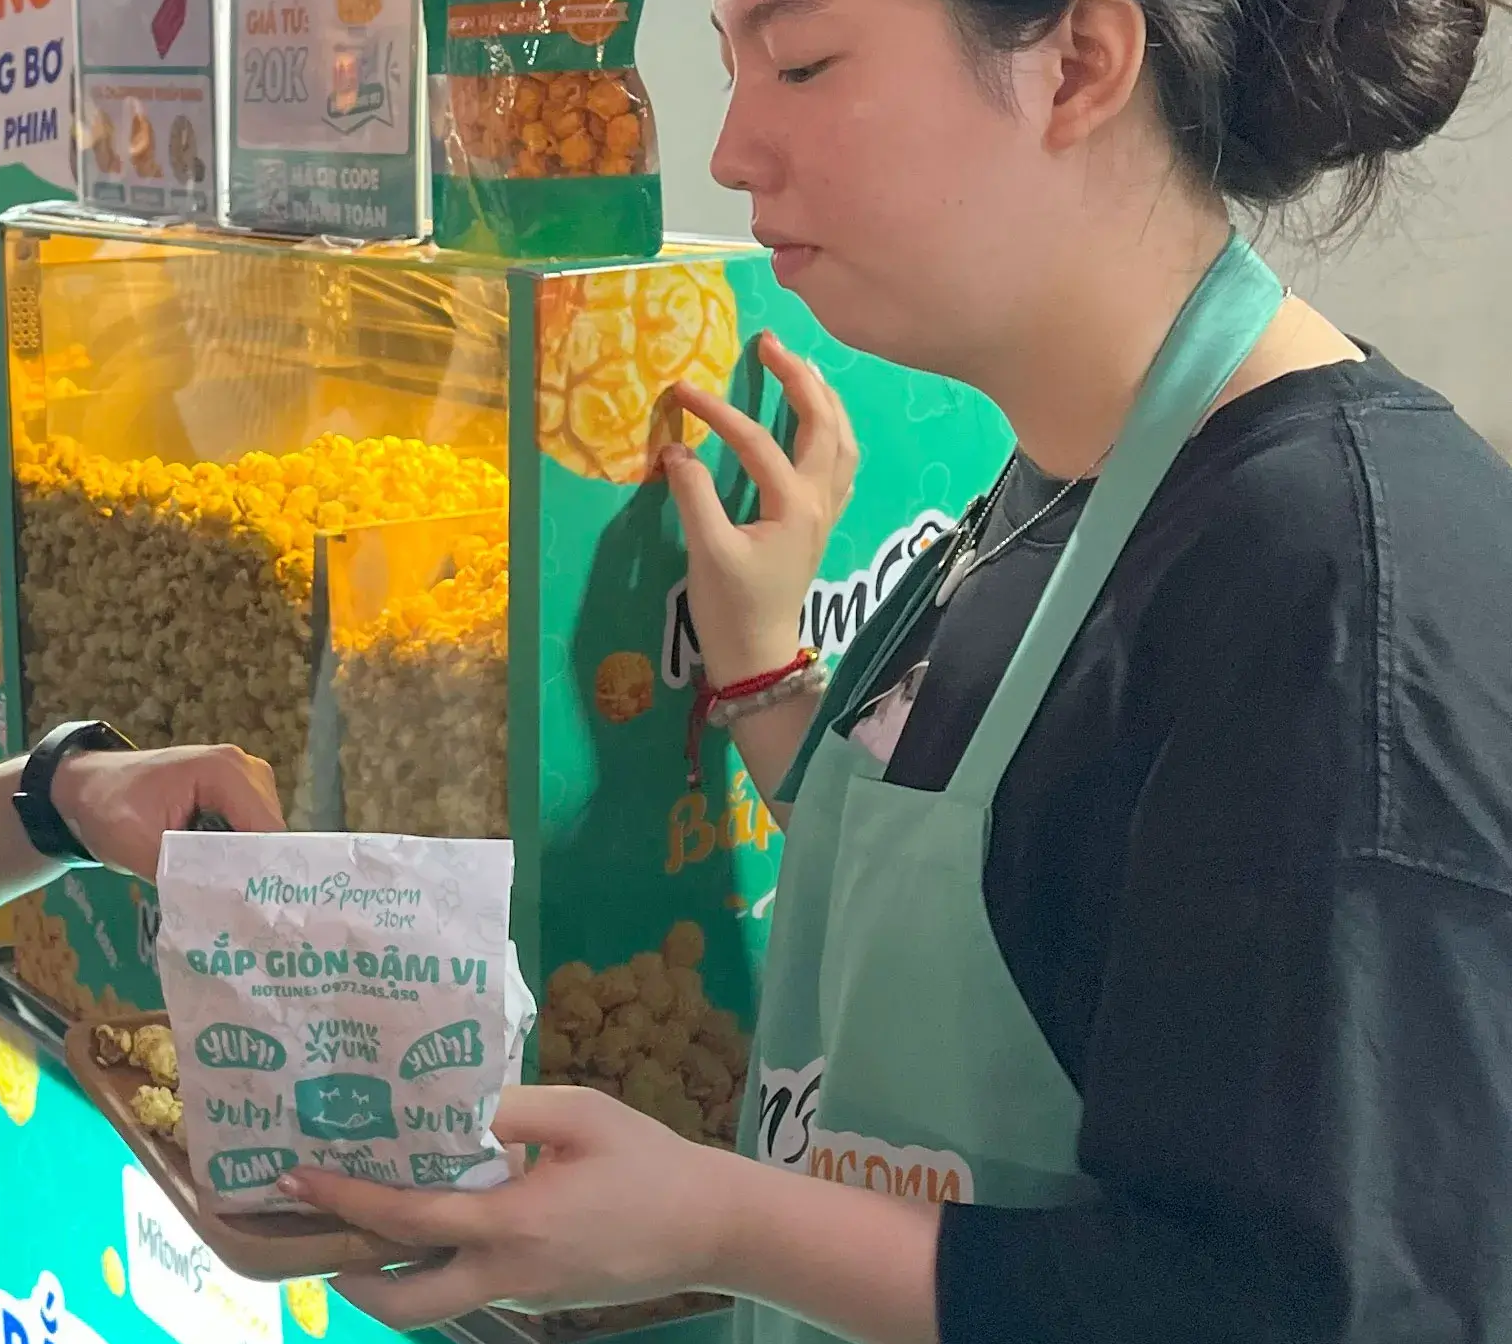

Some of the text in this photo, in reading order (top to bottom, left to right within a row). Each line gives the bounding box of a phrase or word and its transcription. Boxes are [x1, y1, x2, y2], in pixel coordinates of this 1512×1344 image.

[24, 37, 64, 87] BƠ
[244, 46, 309, 104] 20K
[4, 107, 59, 150] PHIM
[338, 885, 421, 910] popcorn
[375, 910, 415, 930] store
[187, 932, 257, 978] BẮP
[265, 943, 349, 979] GIÒN
[353, 945, 440, 989] ĐẬM
[451, 957, 488, 995] VỊ
